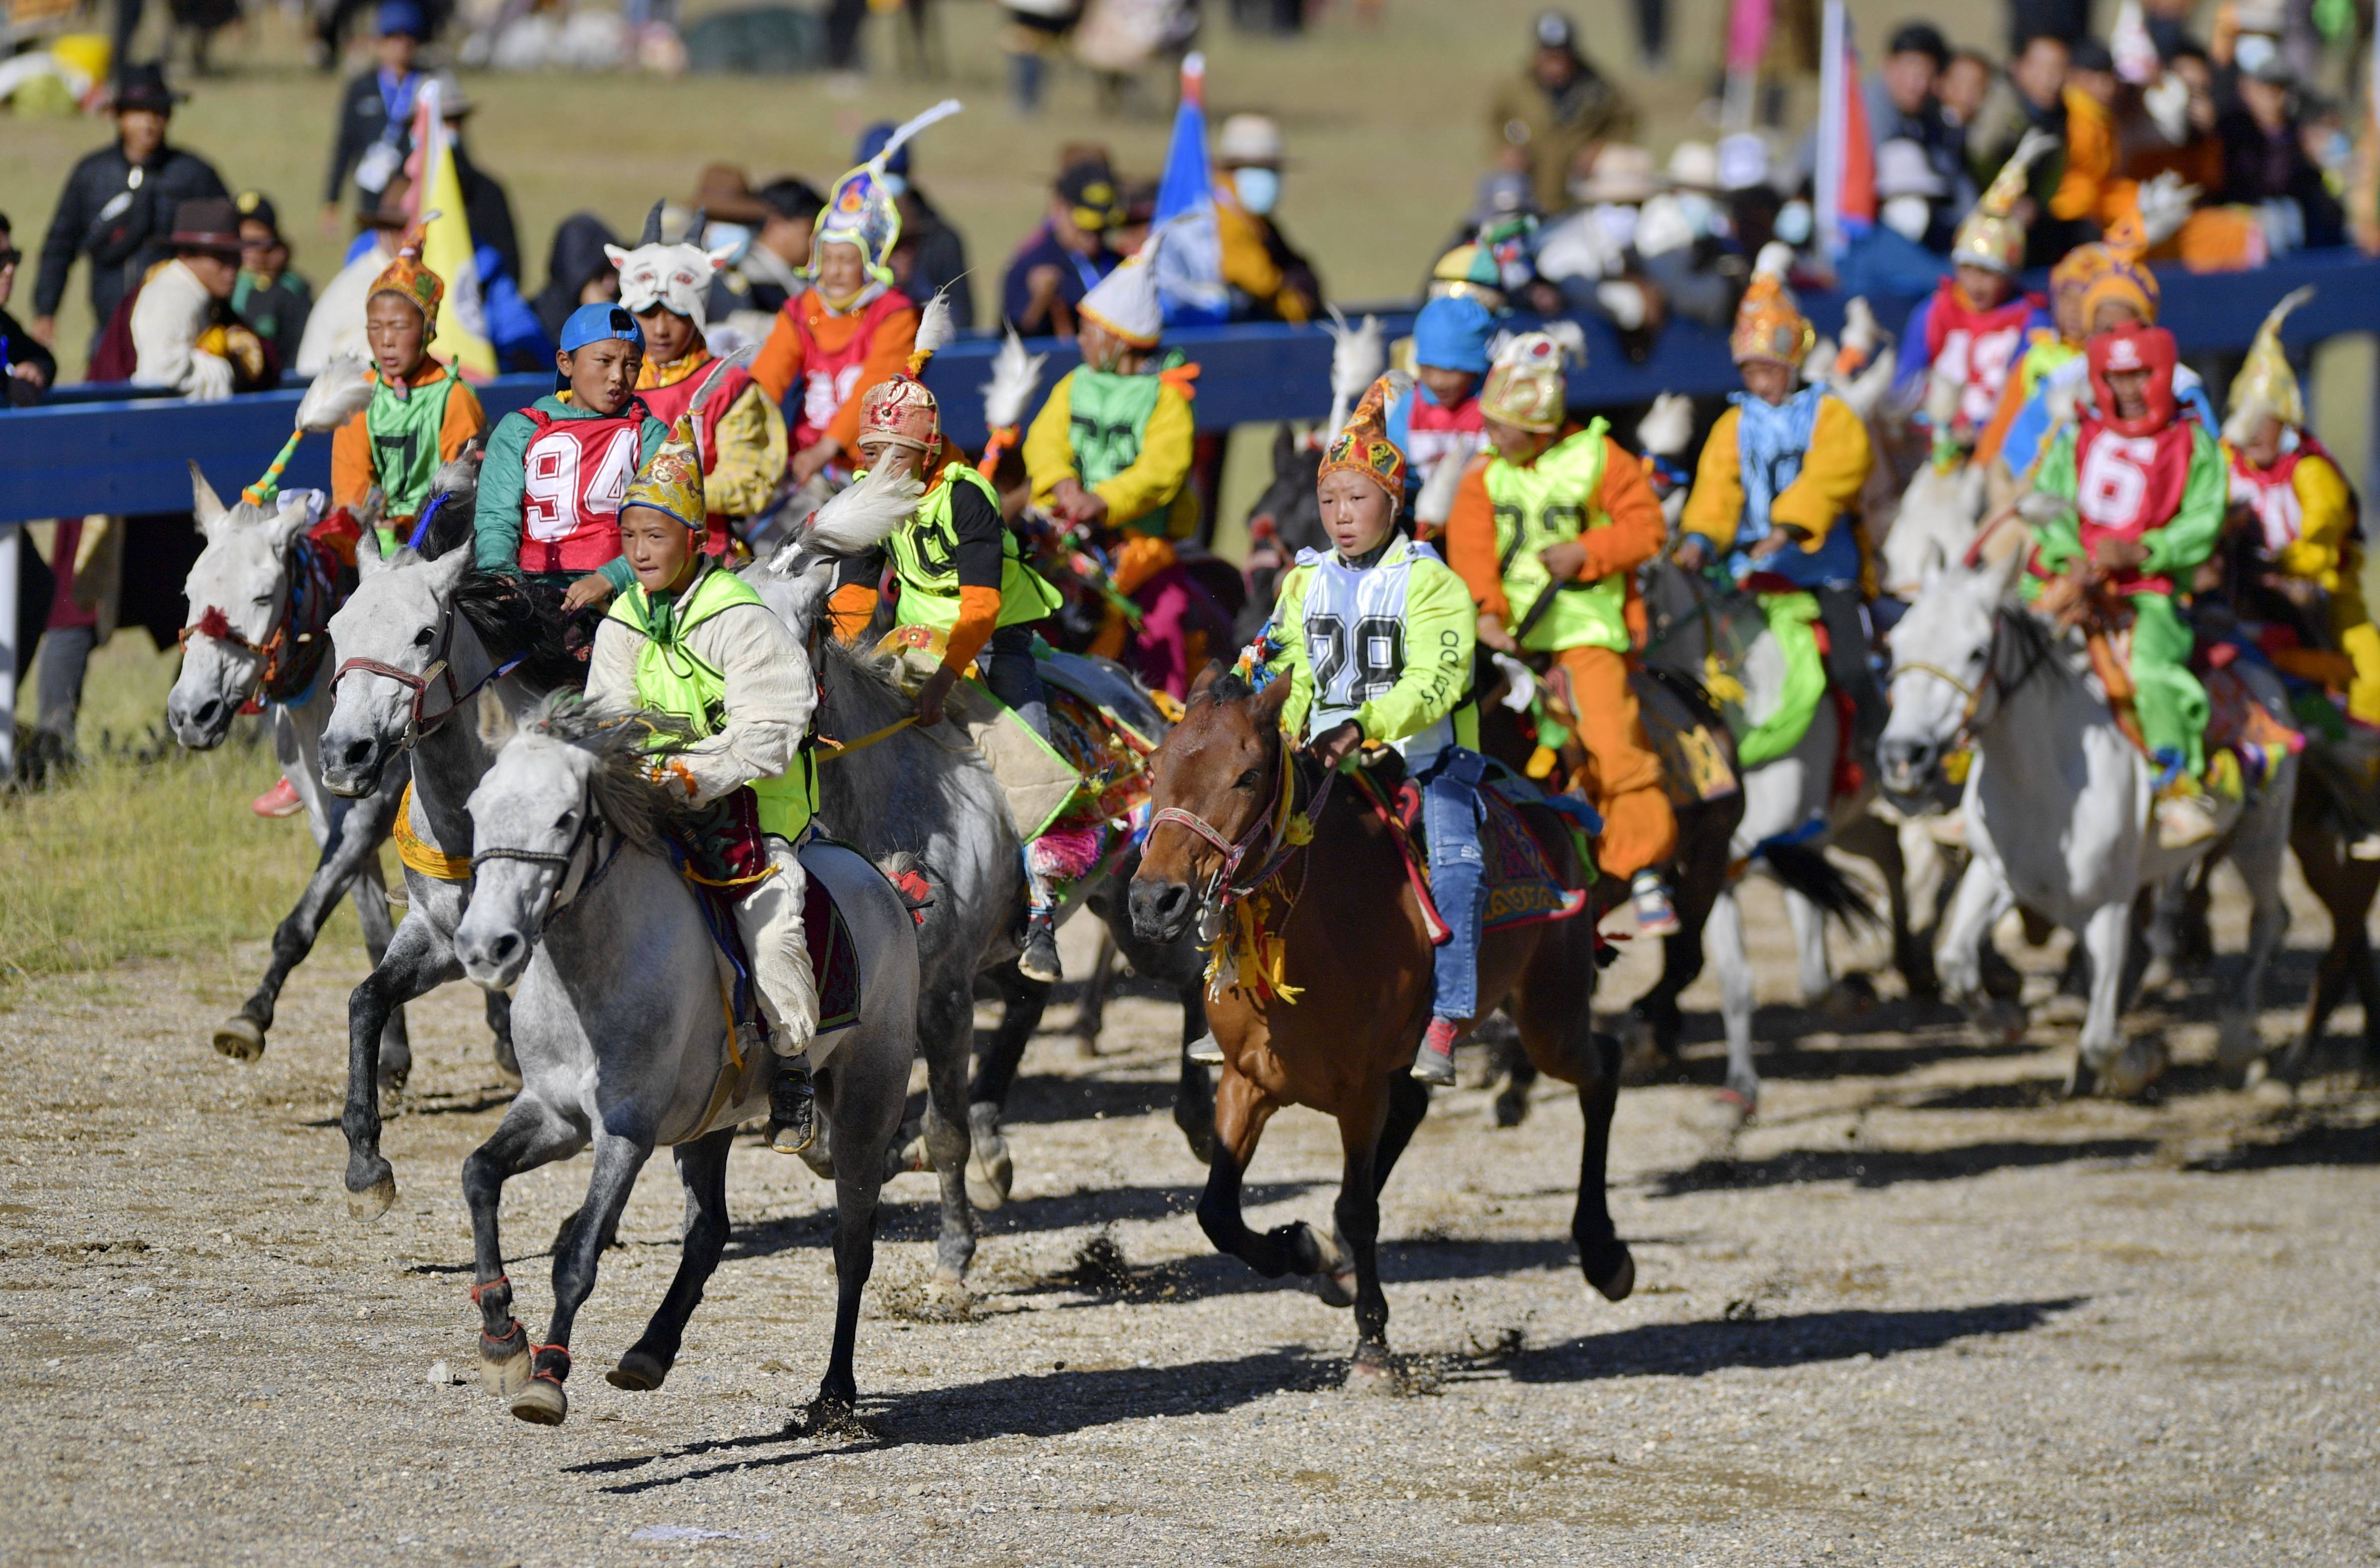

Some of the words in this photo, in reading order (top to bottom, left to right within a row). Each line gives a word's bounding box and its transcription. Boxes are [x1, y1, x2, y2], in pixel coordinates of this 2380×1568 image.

[524, 428, 640, 543] 94
[2077, 429, 2158, 530] 6
[1303, 613, 1407, 716] 28
